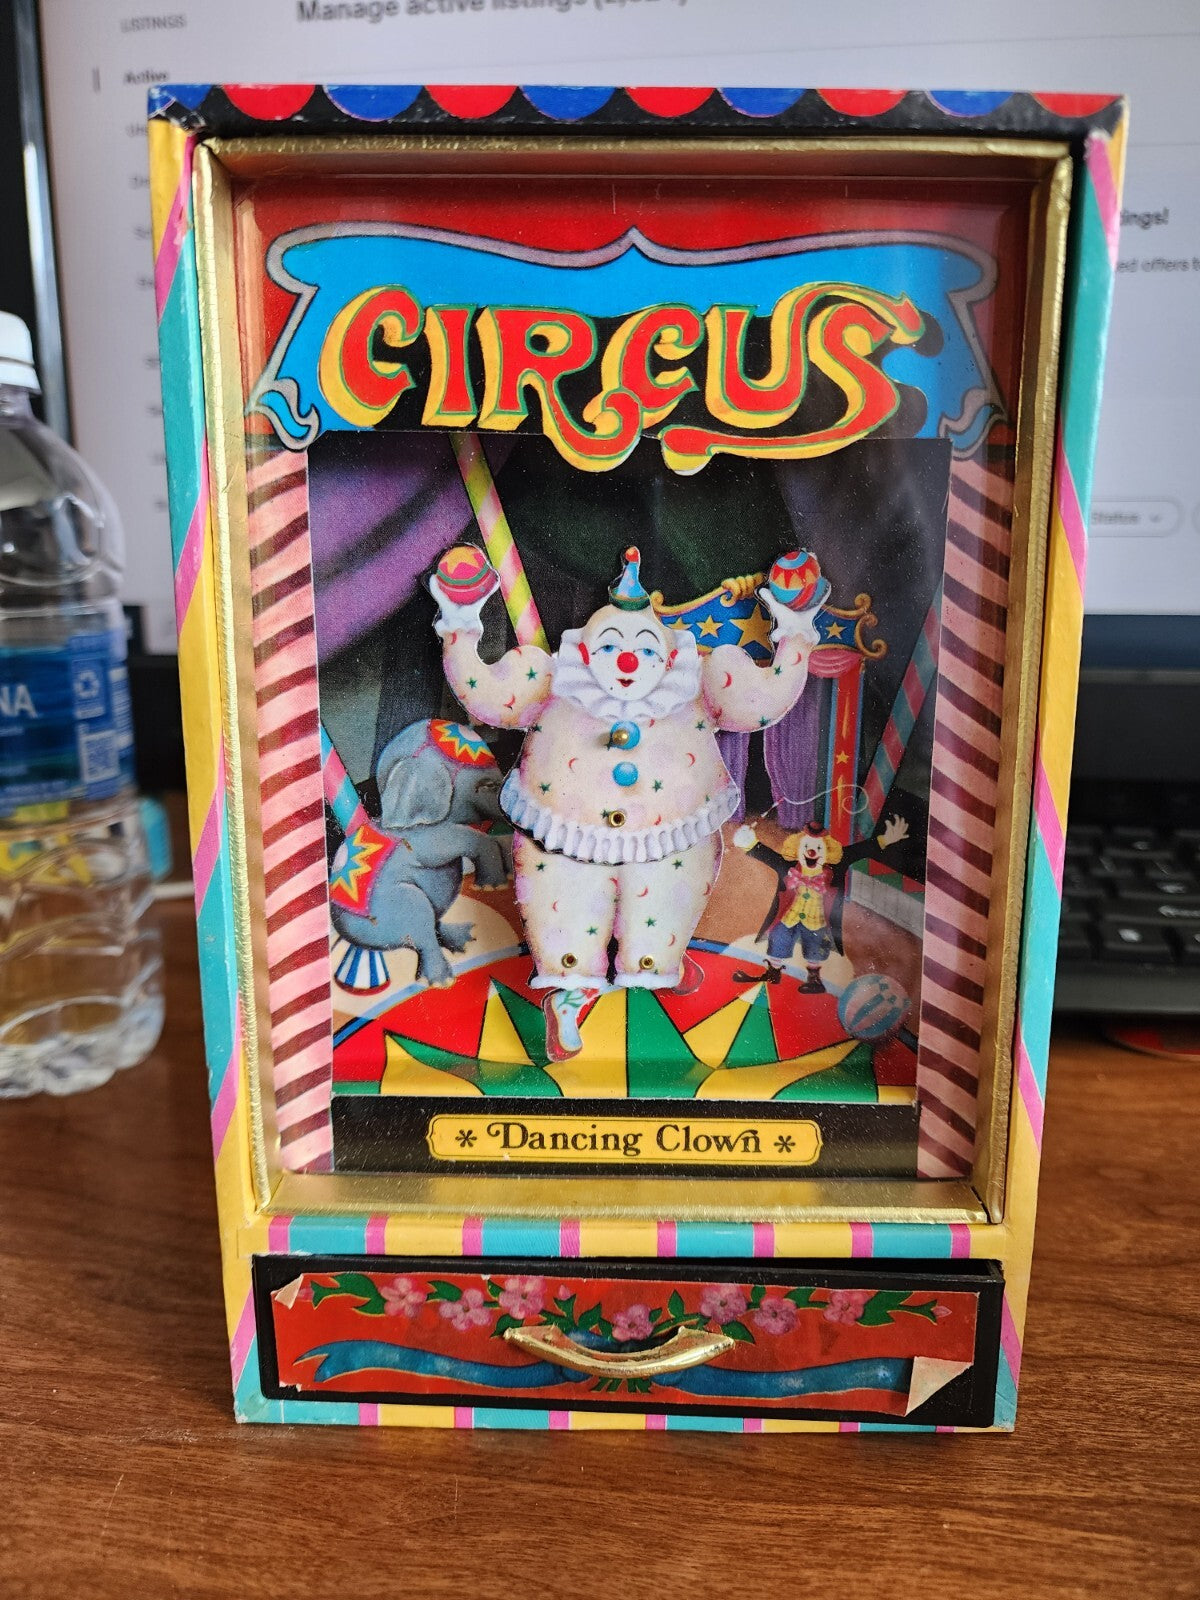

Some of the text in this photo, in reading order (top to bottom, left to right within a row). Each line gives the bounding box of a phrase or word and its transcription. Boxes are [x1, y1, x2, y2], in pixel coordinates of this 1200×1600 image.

[298, 0, 399, 23] Manage
[405, 0, 485, 15] active
[1141, 257, 1190, 273] offers
[318, 282, 924, 475] CIRCUS
[486, 1122, 762, 1157] Dancing Clown
